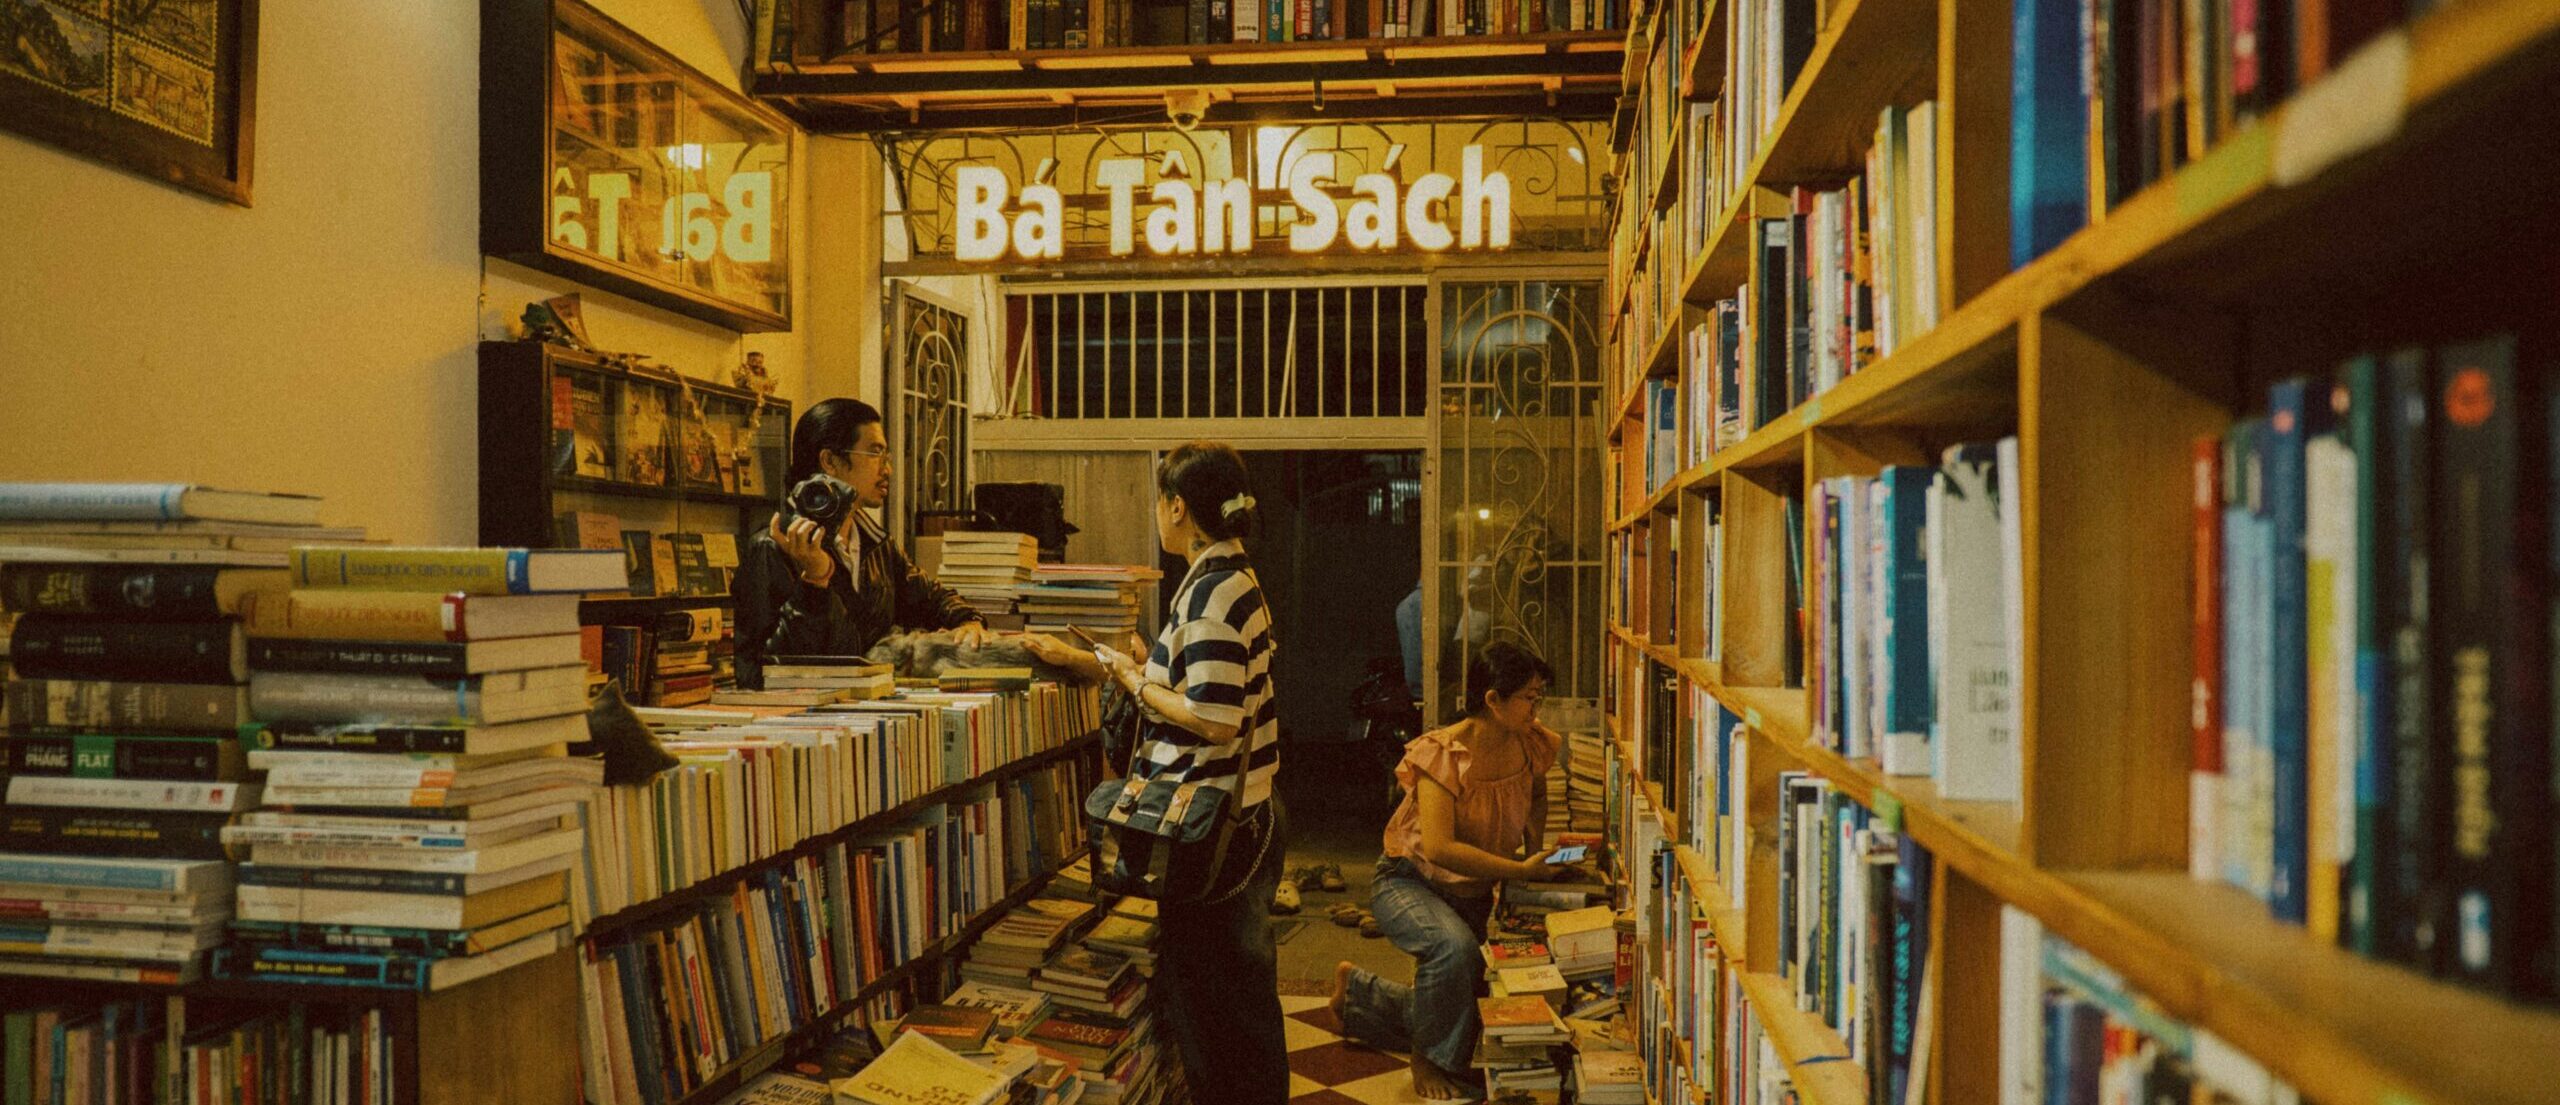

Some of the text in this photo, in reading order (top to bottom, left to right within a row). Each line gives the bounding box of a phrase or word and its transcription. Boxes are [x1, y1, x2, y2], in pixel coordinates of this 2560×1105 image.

[954, 143, 1512, 262] Bá Tân Sách
[77, 753, 111, 769] FLAT
